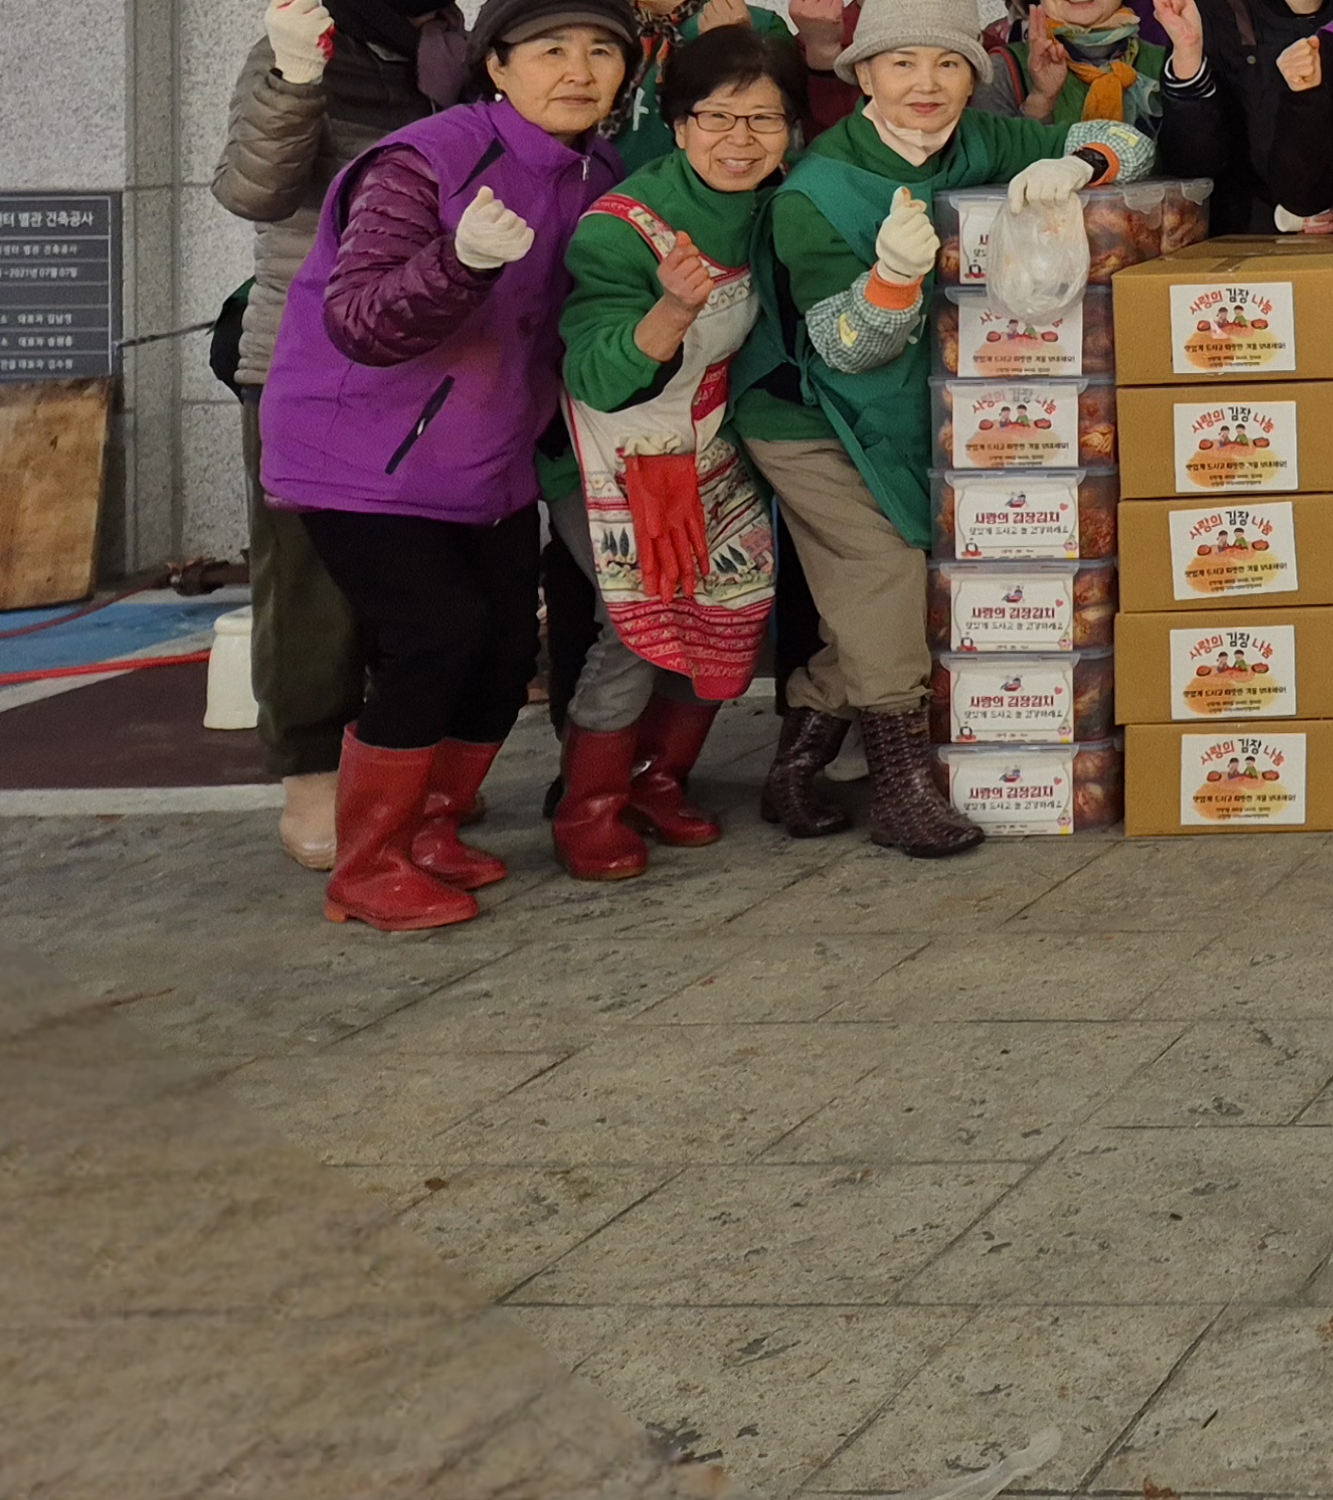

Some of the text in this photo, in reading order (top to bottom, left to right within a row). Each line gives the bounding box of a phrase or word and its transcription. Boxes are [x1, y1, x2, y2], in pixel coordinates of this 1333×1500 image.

[18, 211, 43, 228] 별관
[46, 210, 95, 228] 건축공사
[1190, 287, 1272, 316] 사랑의 김장 나눔
[975, 512, 1009, 525] 사랑의
[971, 606, 1006, 619] 사랑의
[970, 695, 1004, 708] 사랑의
[969, 786, 1003, 800] 사랑의
